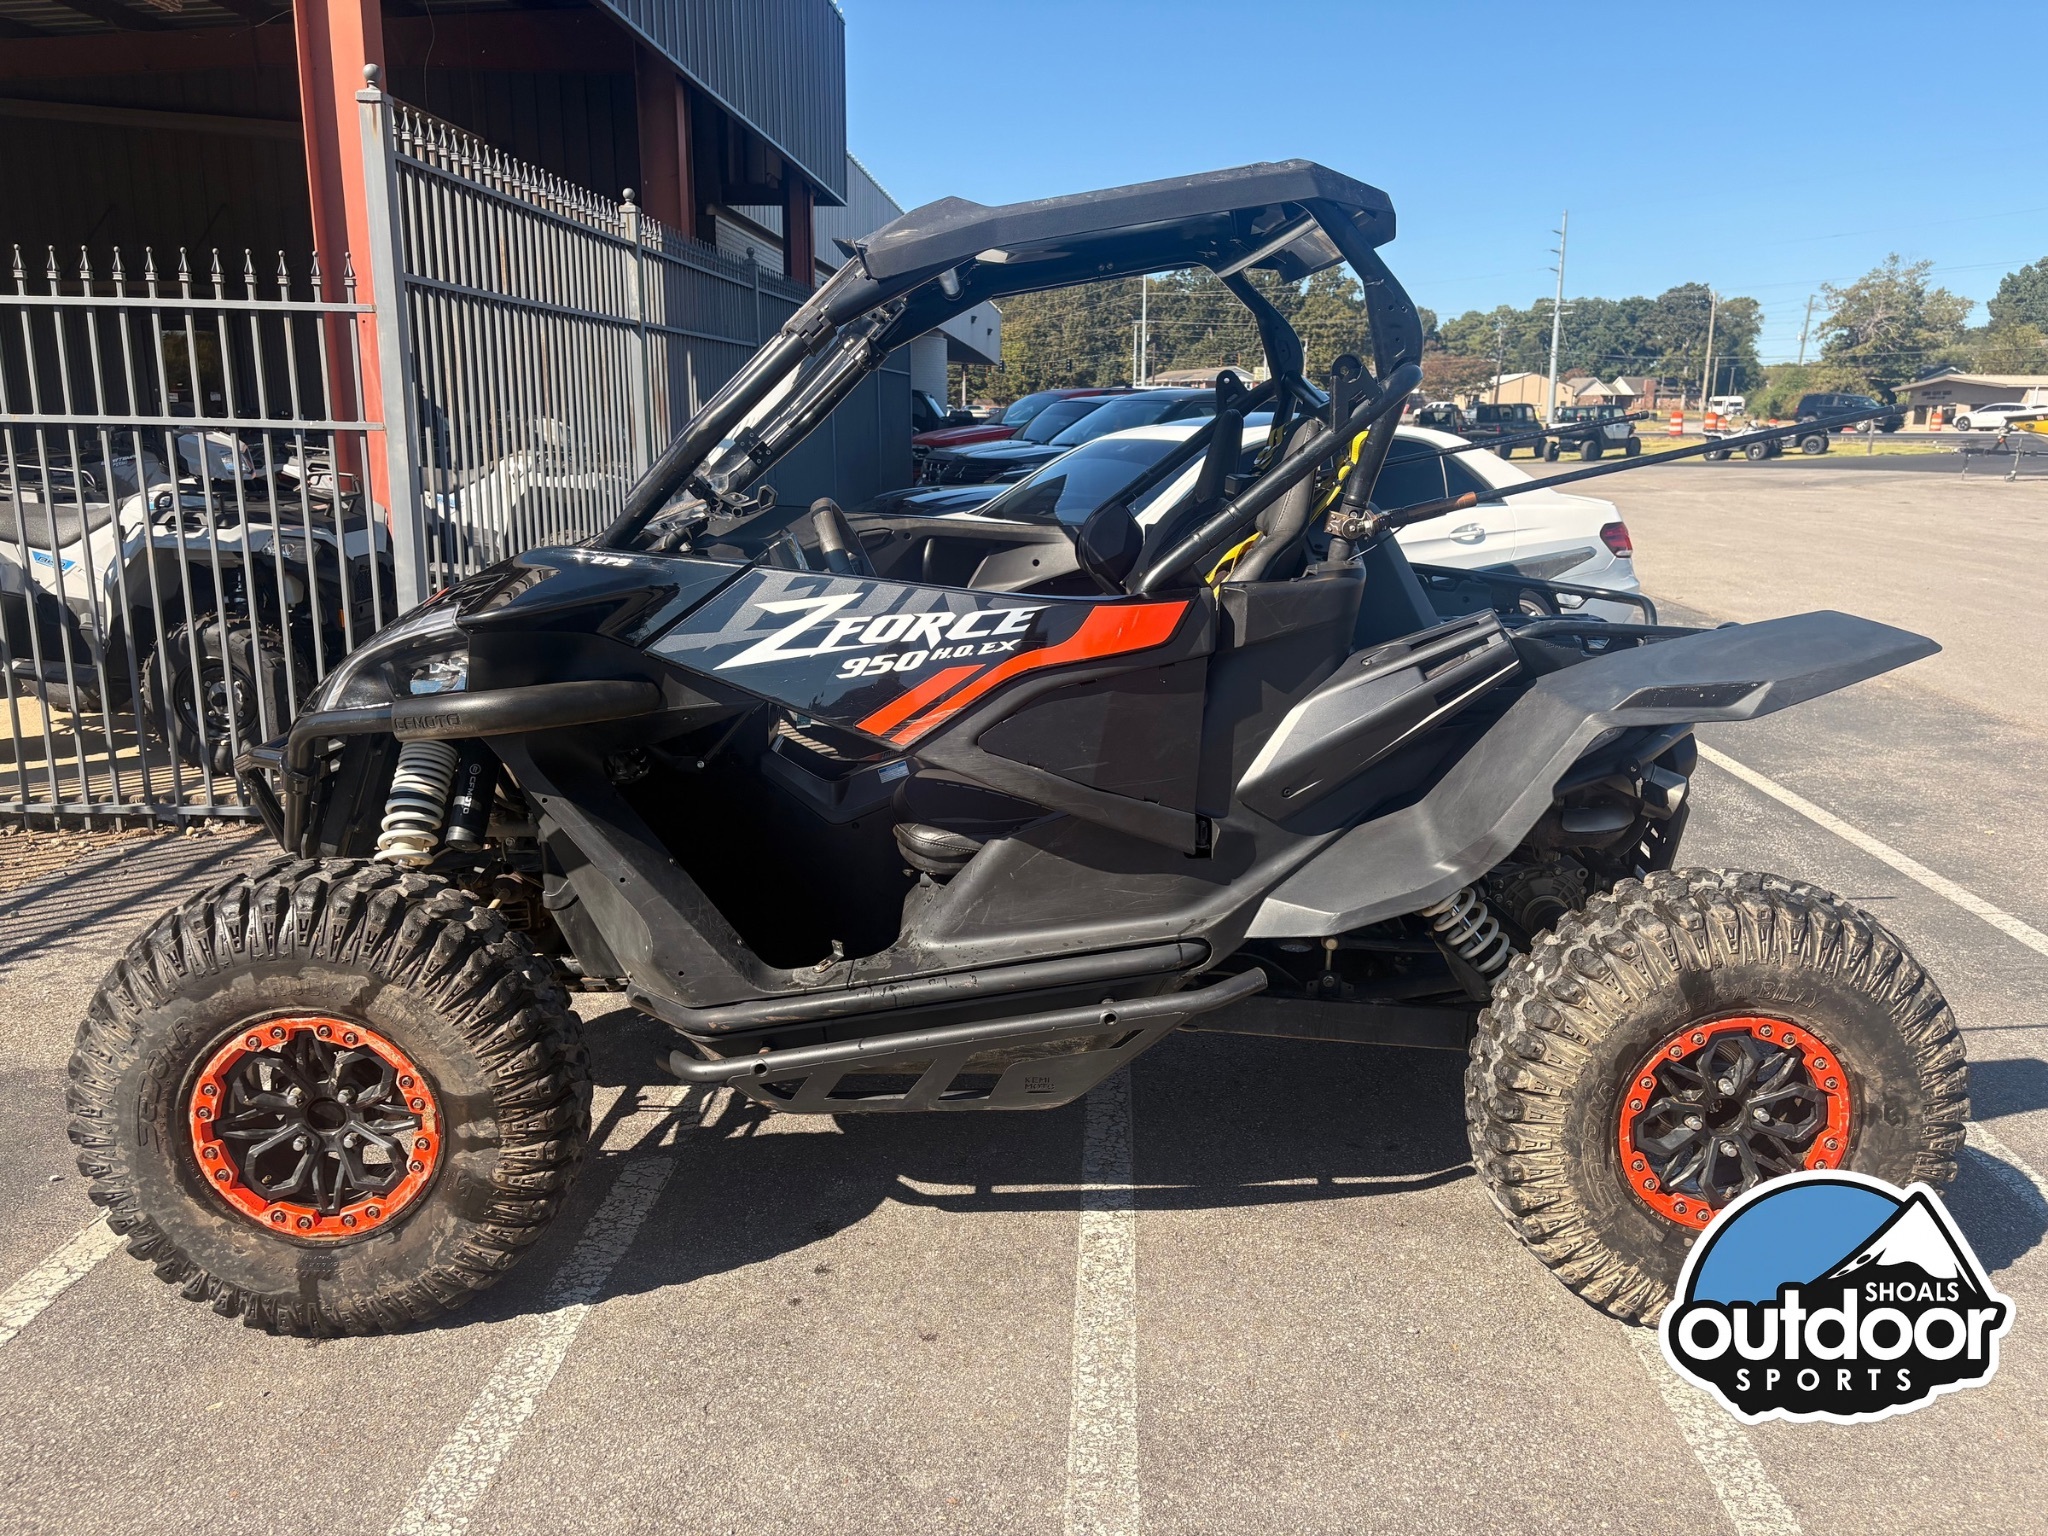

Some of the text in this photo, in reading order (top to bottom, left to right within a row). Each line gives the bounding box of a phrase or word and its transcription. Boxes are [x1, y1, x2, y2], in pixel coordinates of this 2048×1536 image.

[590, 555, 634, 567] EPS
[836, 638, 1023, 680] 950 H.O. EX
